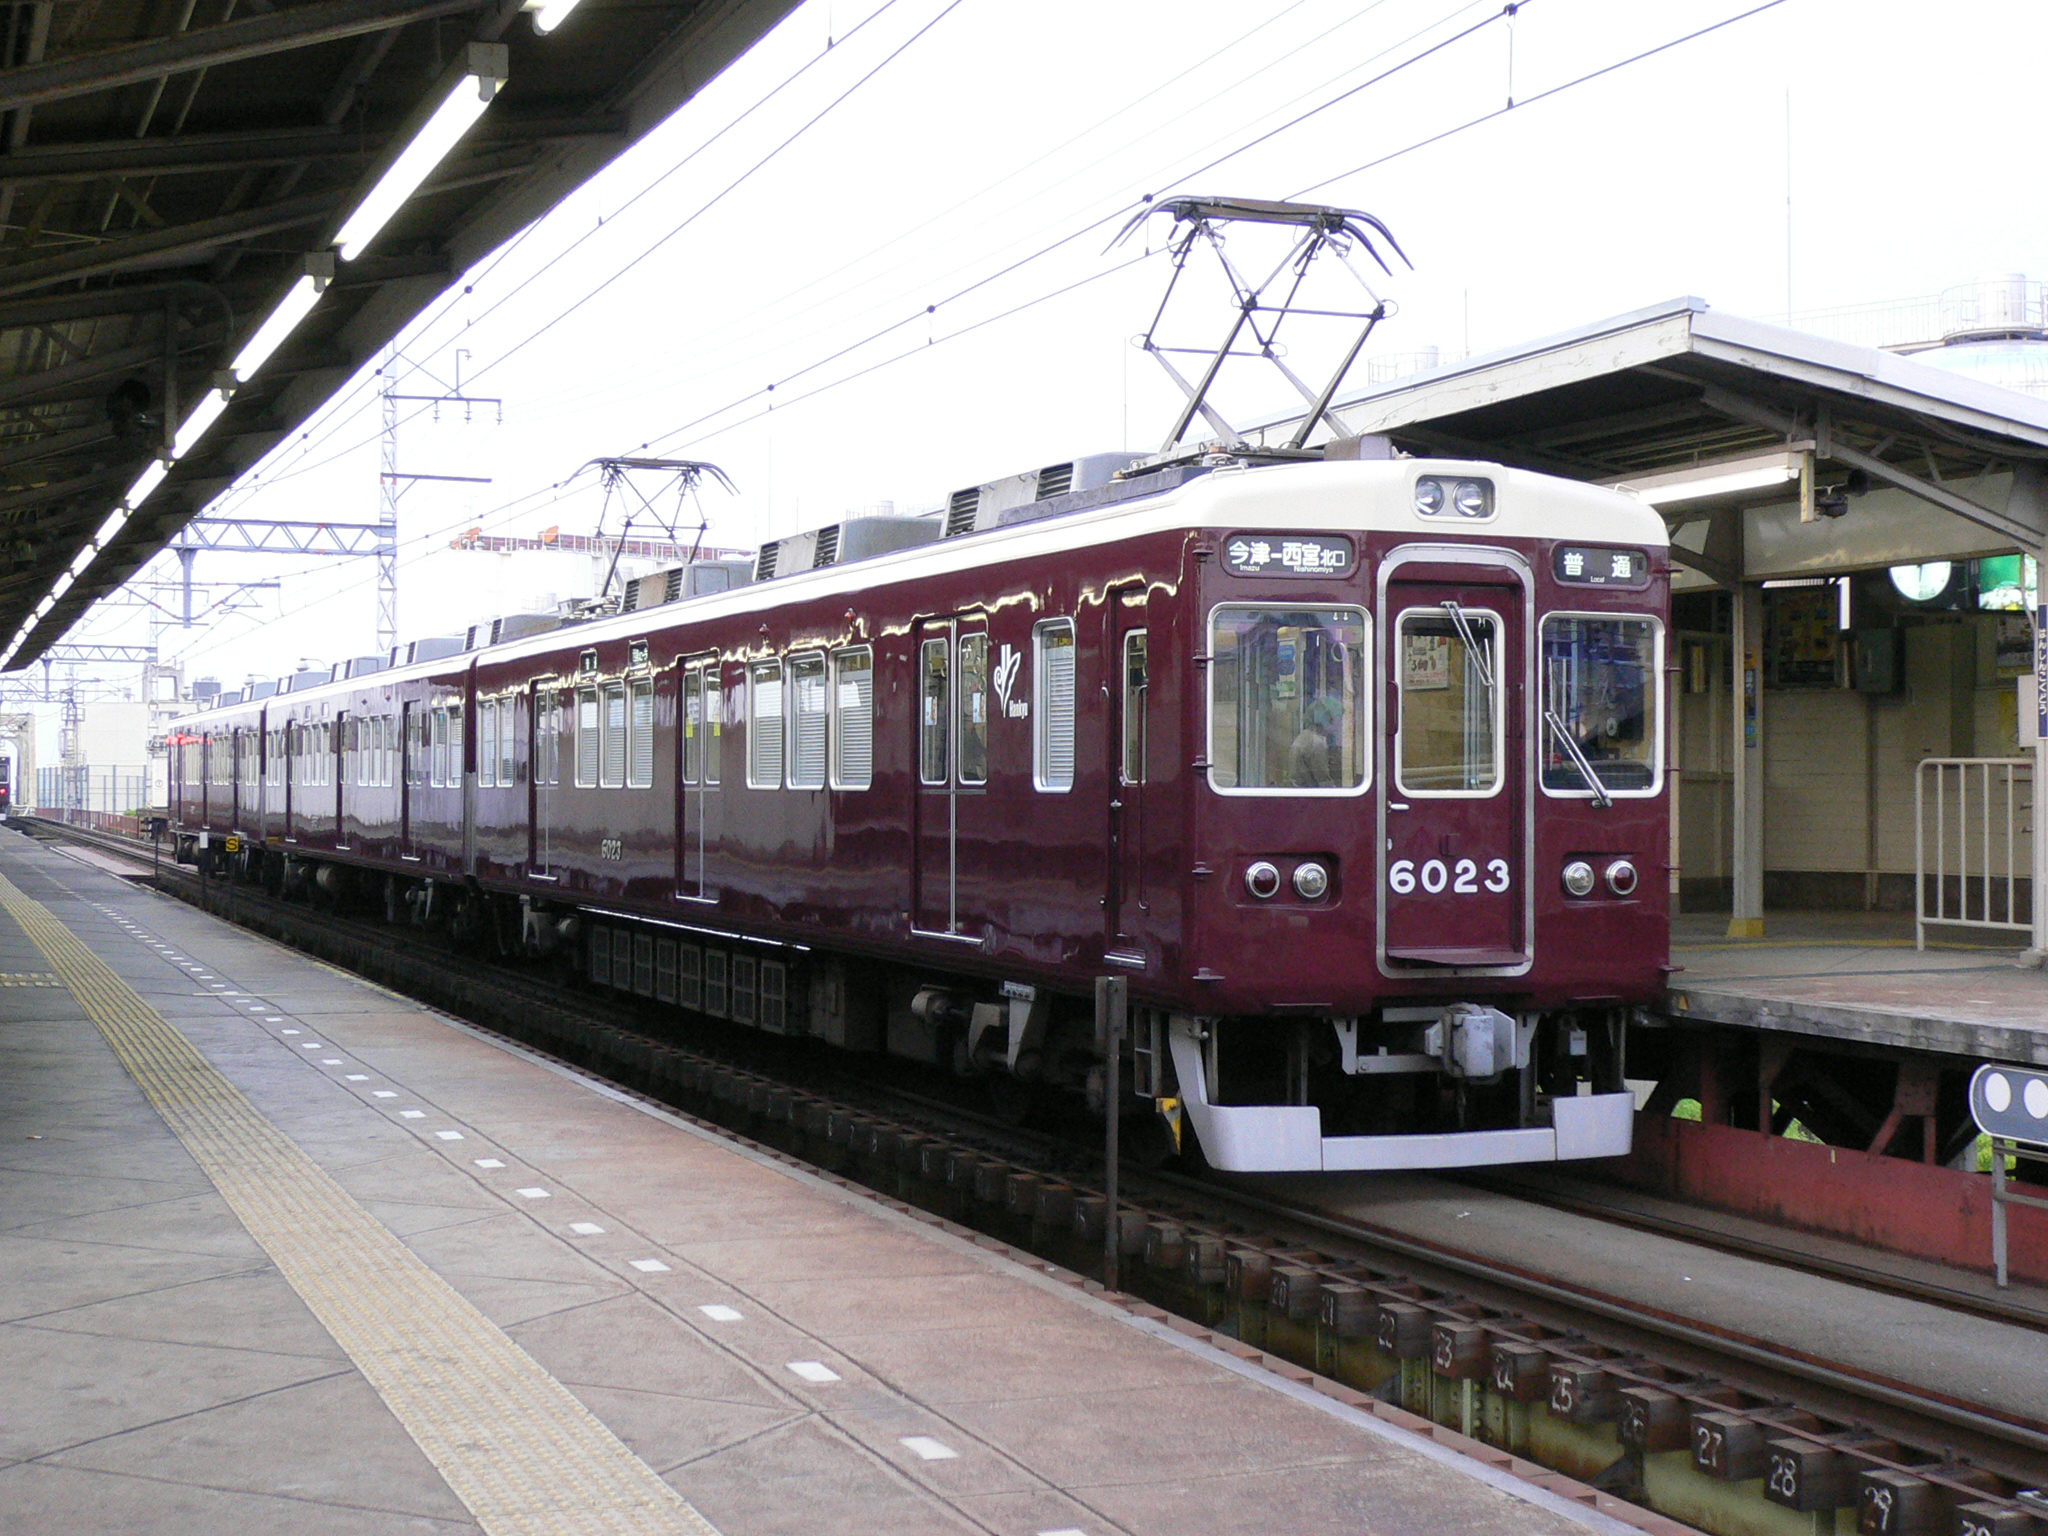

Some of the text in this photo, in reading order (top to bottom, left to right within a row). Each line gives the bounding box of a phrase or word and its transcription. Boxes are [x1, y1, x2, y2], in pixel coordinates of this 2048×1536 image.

[1239, 564, 1334, 574] Imazu Nishinomiya
[1590, 575, 1606, 583] Local
[227, 838, 237, 850] S
[1389, 858, 1511, 894] 6023
[1551, 1373, 1573, 1414] 25
[1697, 1425, 1723, 1468] 27
[1770, 1454, 1797, 1498] 28
[1864, 1486, 1893, 1532] 29
